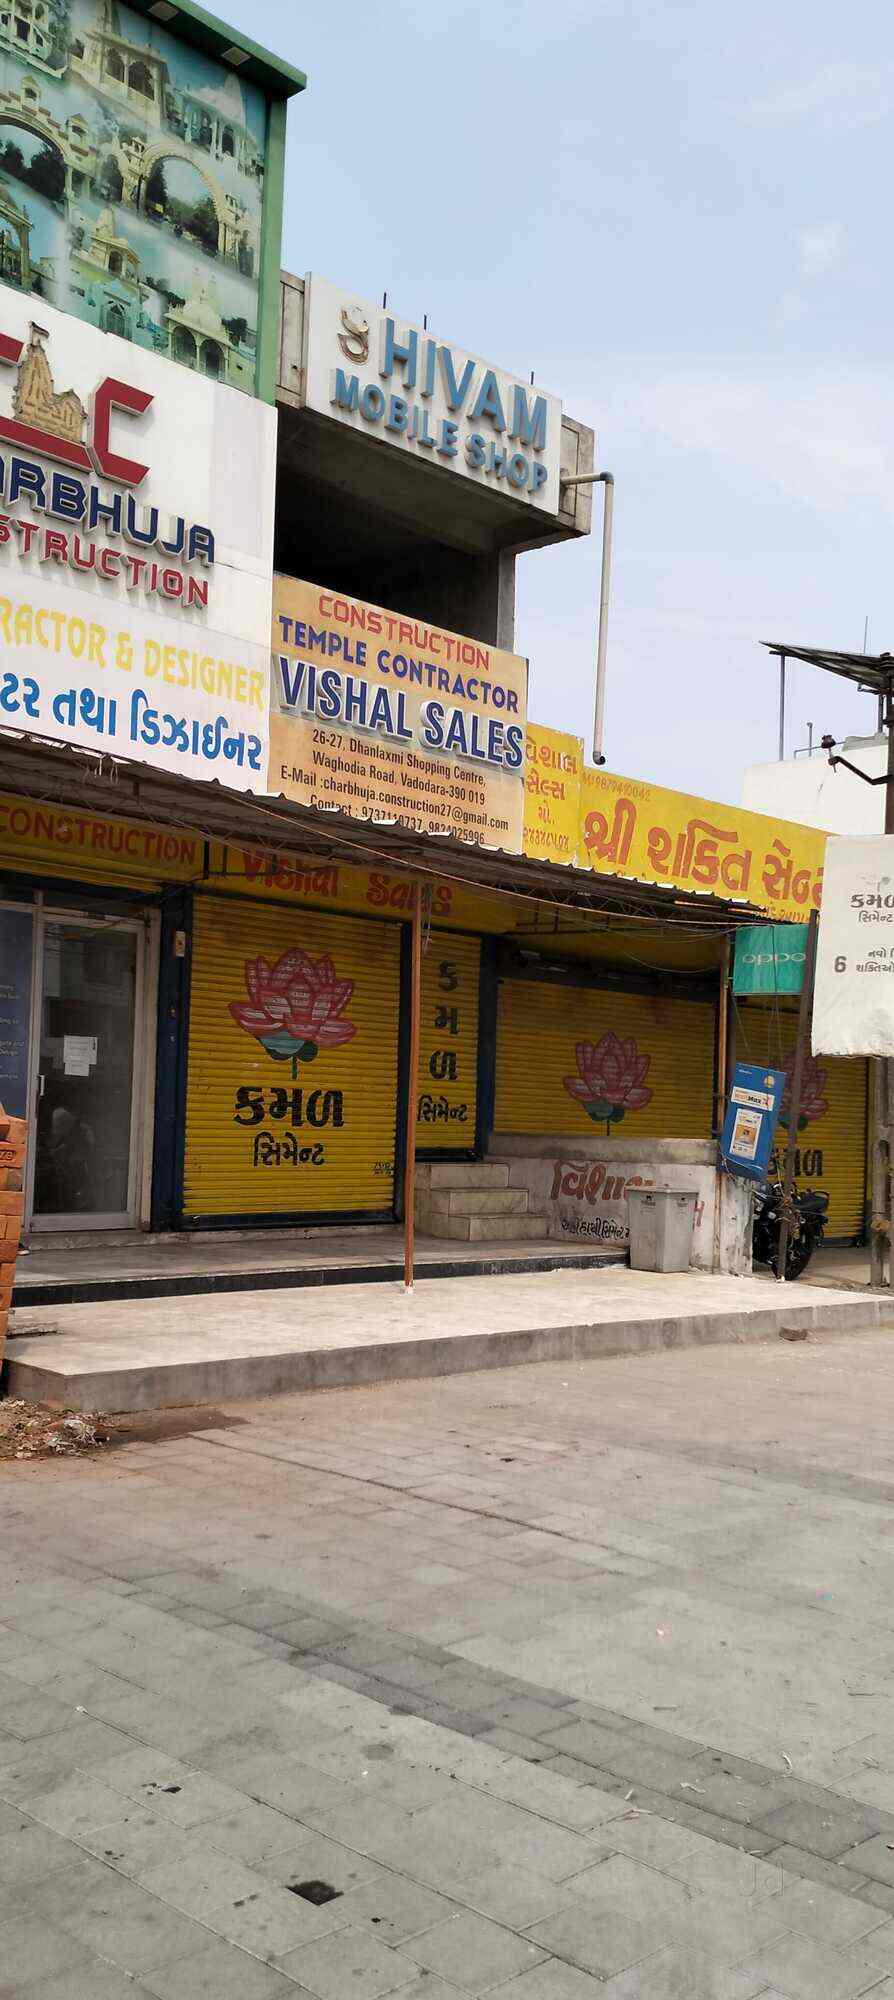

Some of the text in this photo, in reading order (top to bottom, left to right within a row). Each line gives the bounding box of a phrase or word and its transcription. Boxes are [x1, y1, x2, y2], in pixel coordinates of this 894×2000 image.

[338, 305, 547, 452] SHIVAM
[331, 367, 548, 495] MOBILE SHOP
[0, 456, 215, 565] RBHUJA
[279, 615, 519, 713] TEMPLE CONTRACTOR
[319, 595, 490, 671] CONSTRUCTION
[144, 640, 264, 712] DESIGNER
[53, 687, 116, 737] તથા
[278, 656, 524, 769] VISHAL SALES
[281, 765, 317, 787] E-Mail
[312, 728, 487, 787] 26-27, Dhanlaxmi Shopping Centre,
[312, 750, 486, 806] Waghodia Road, Vadodara-390 019
[583, 798, 637, 866] શ્રી
[834, 955, 847, 973] 6
[234, 1086, 345, 1128] કમળ
[253, 1131, 325, 1167] સિમેન્ટ
